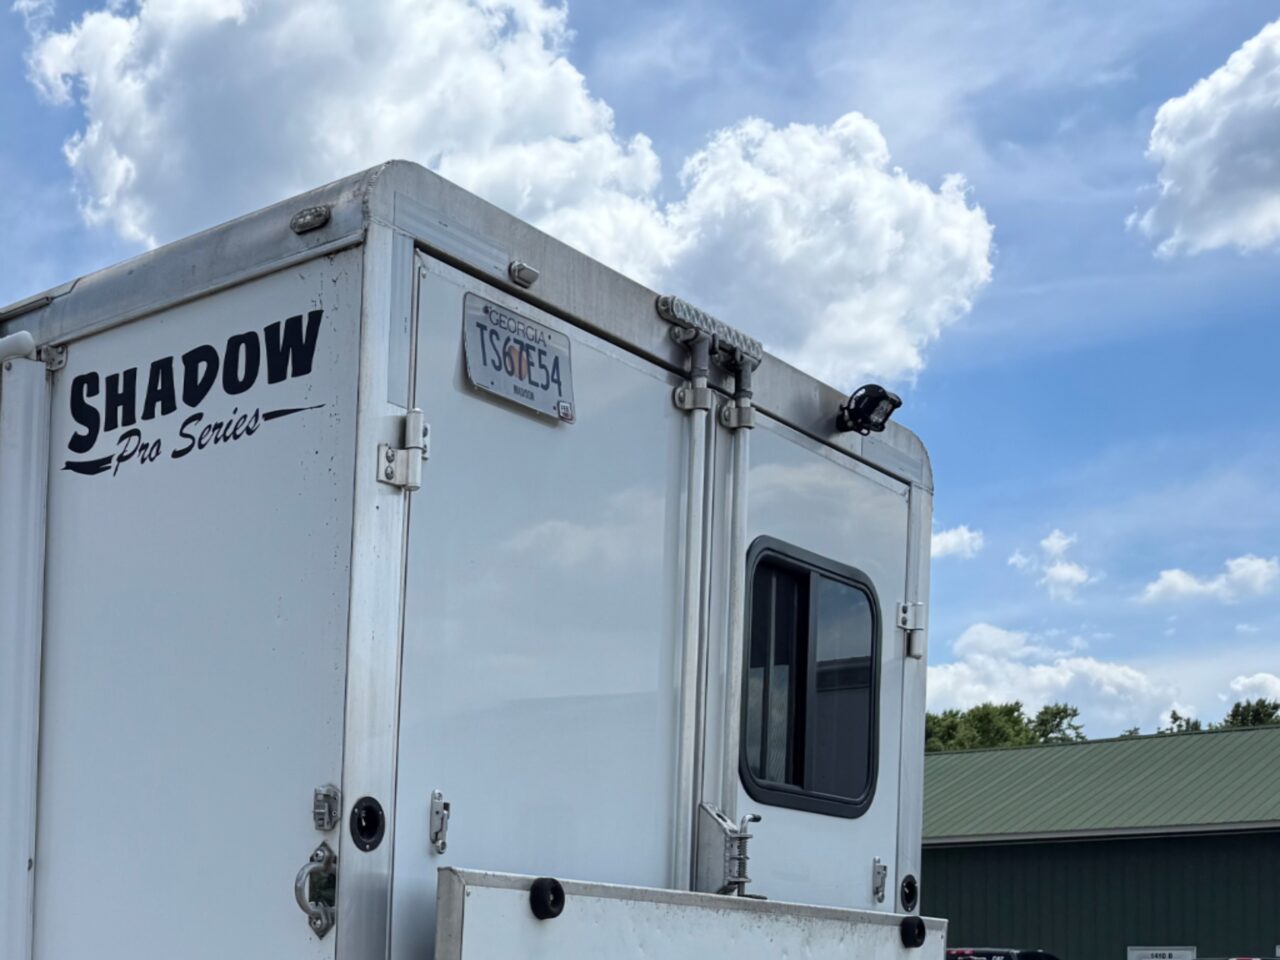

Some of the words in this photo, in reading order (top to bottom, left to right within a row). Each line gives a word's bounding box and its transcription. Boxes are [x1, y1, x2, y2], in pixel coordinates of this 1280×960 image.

[476, 321, 563, 398] TS67E54
[488, 308, 547, 347] GEORGIA
[67, 309, 325, 454] SHADOW
[112, 428, 162, 477] Pro
[171, 406, 261, 459] Series
